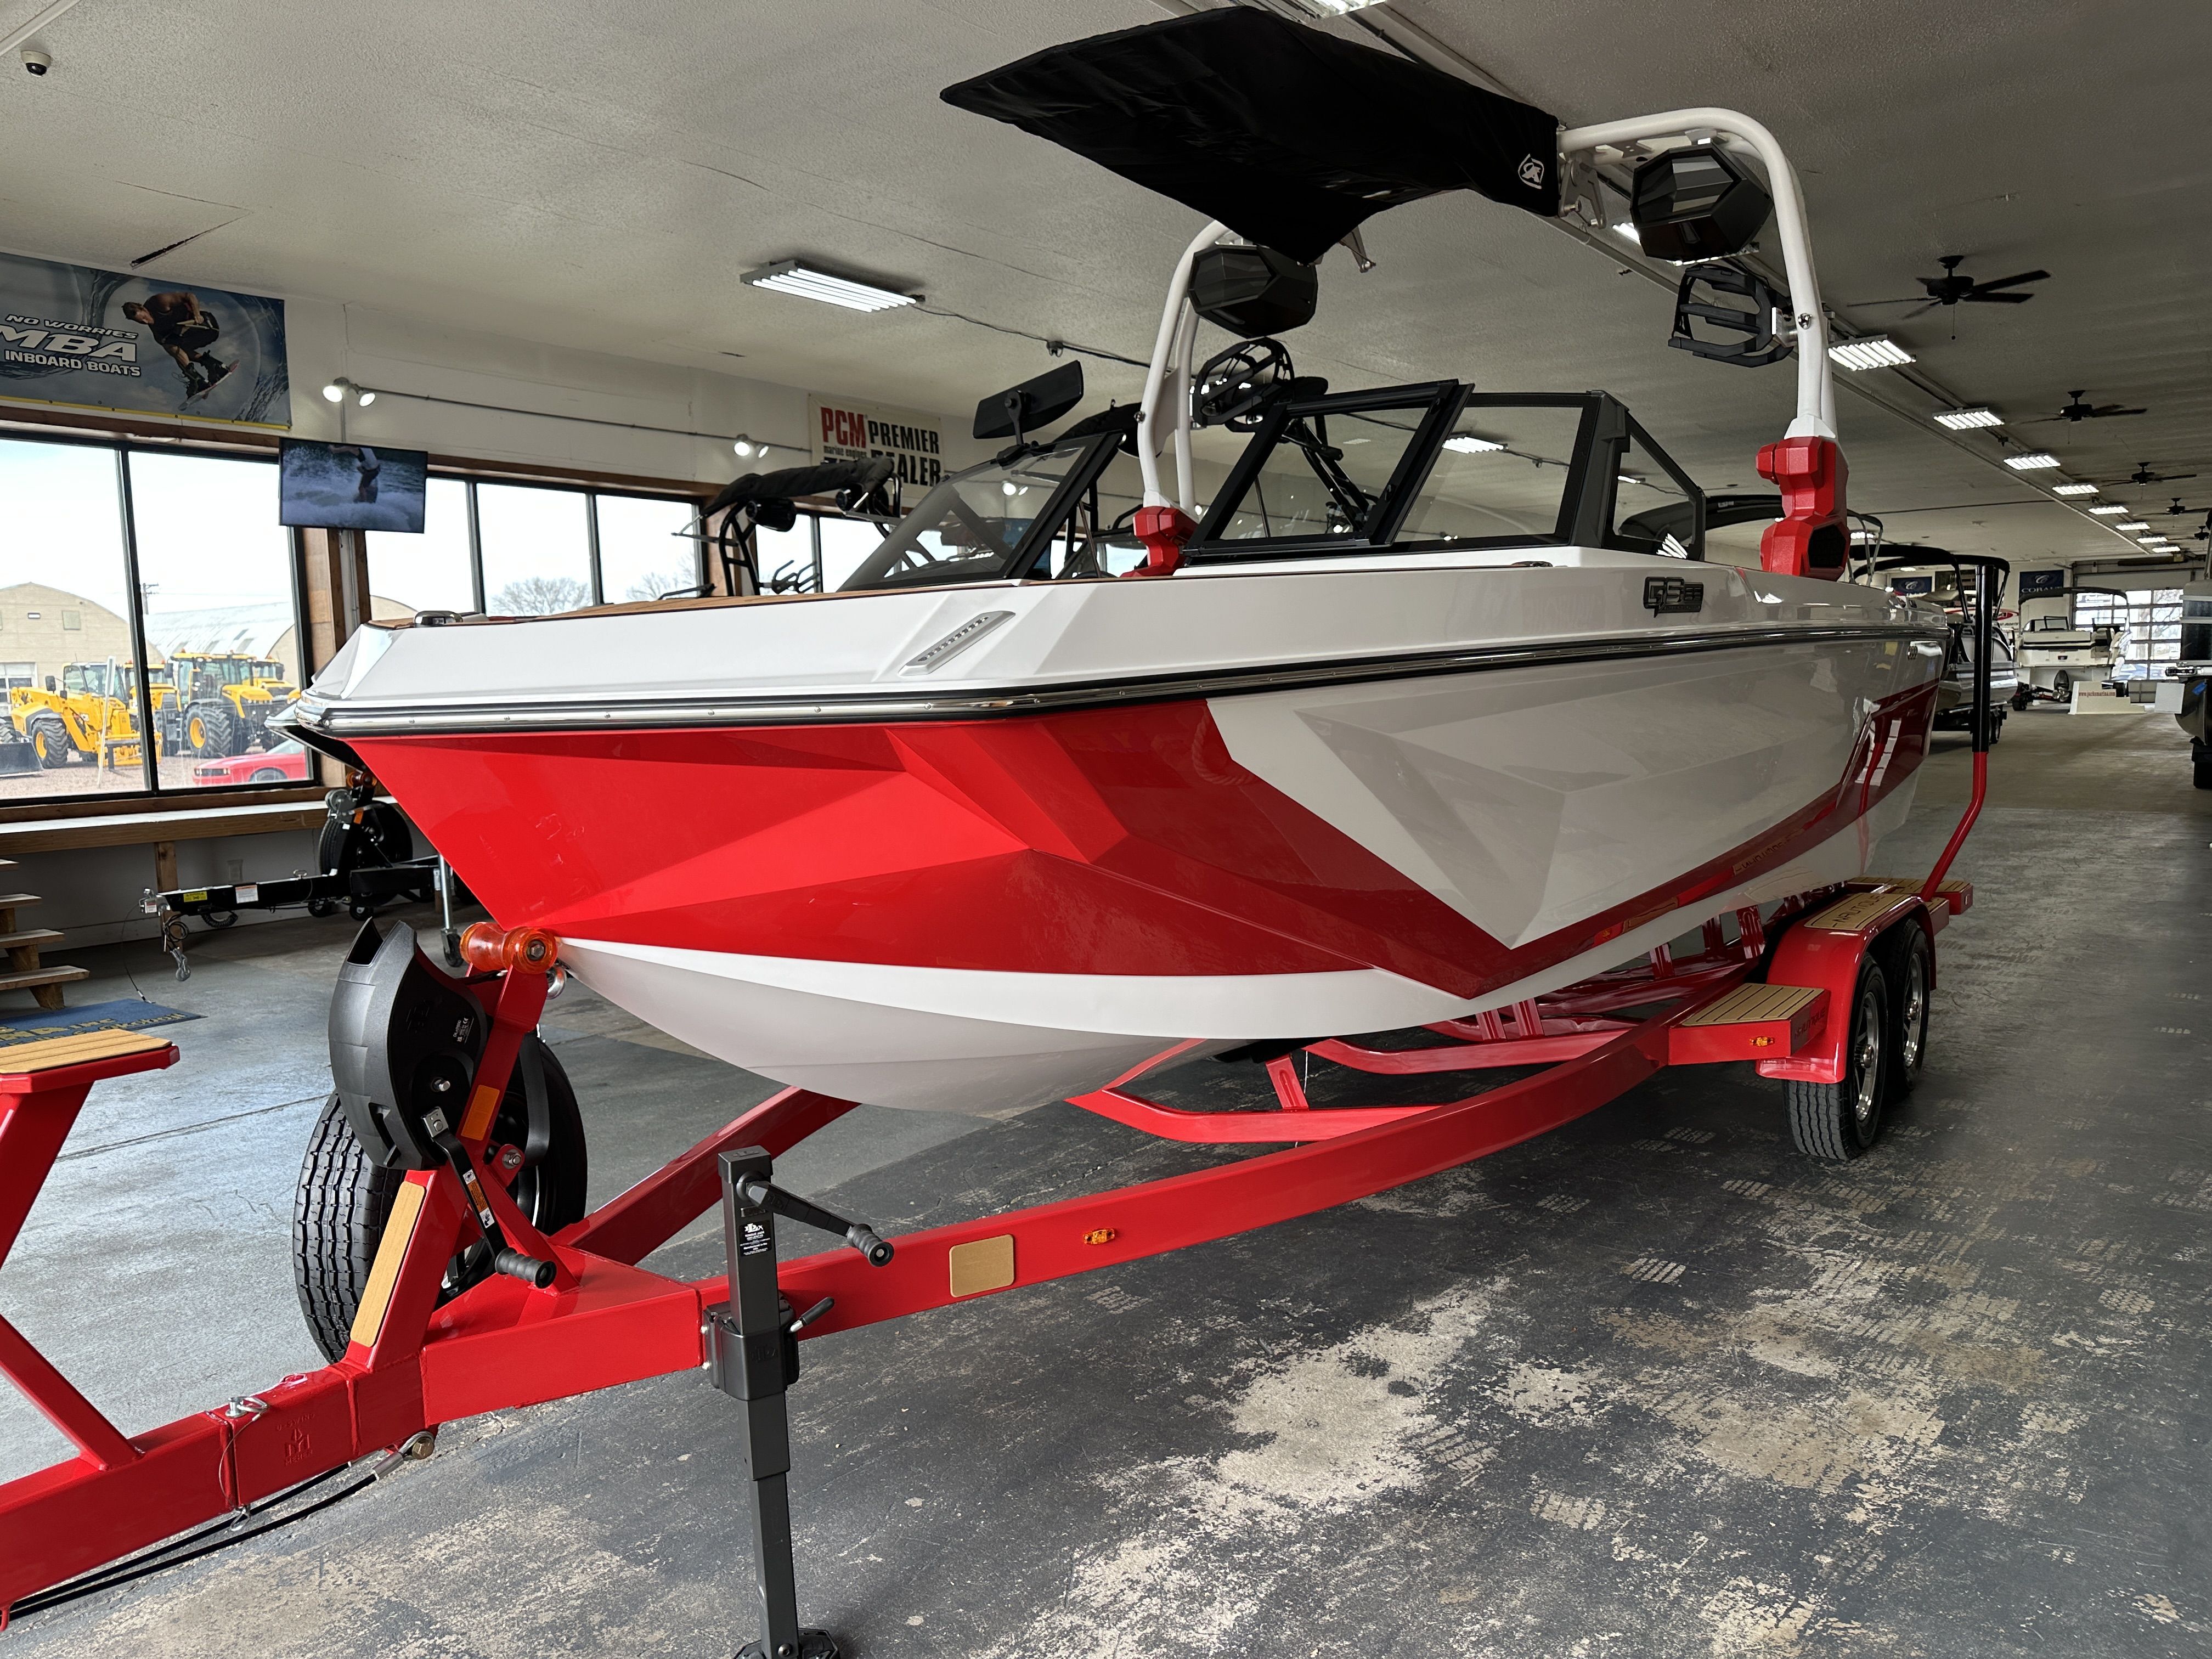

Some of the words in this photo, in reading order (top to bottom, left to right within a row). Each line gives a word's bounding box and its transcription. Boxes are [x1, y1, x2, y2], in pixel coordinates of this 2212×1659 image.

[5, 315, 40, 325] NO
[44, 320, 138, 339] WORRIES
[4, 350, 82, 369] INBOARD
[87, 361, 141, 376] BOATS
[820, 407, 866, 448] PCM
[867, 420, 939, 454] PREMIER
[823, 445, 844, 456] marine
[871, 449, 941, 487] ALER
